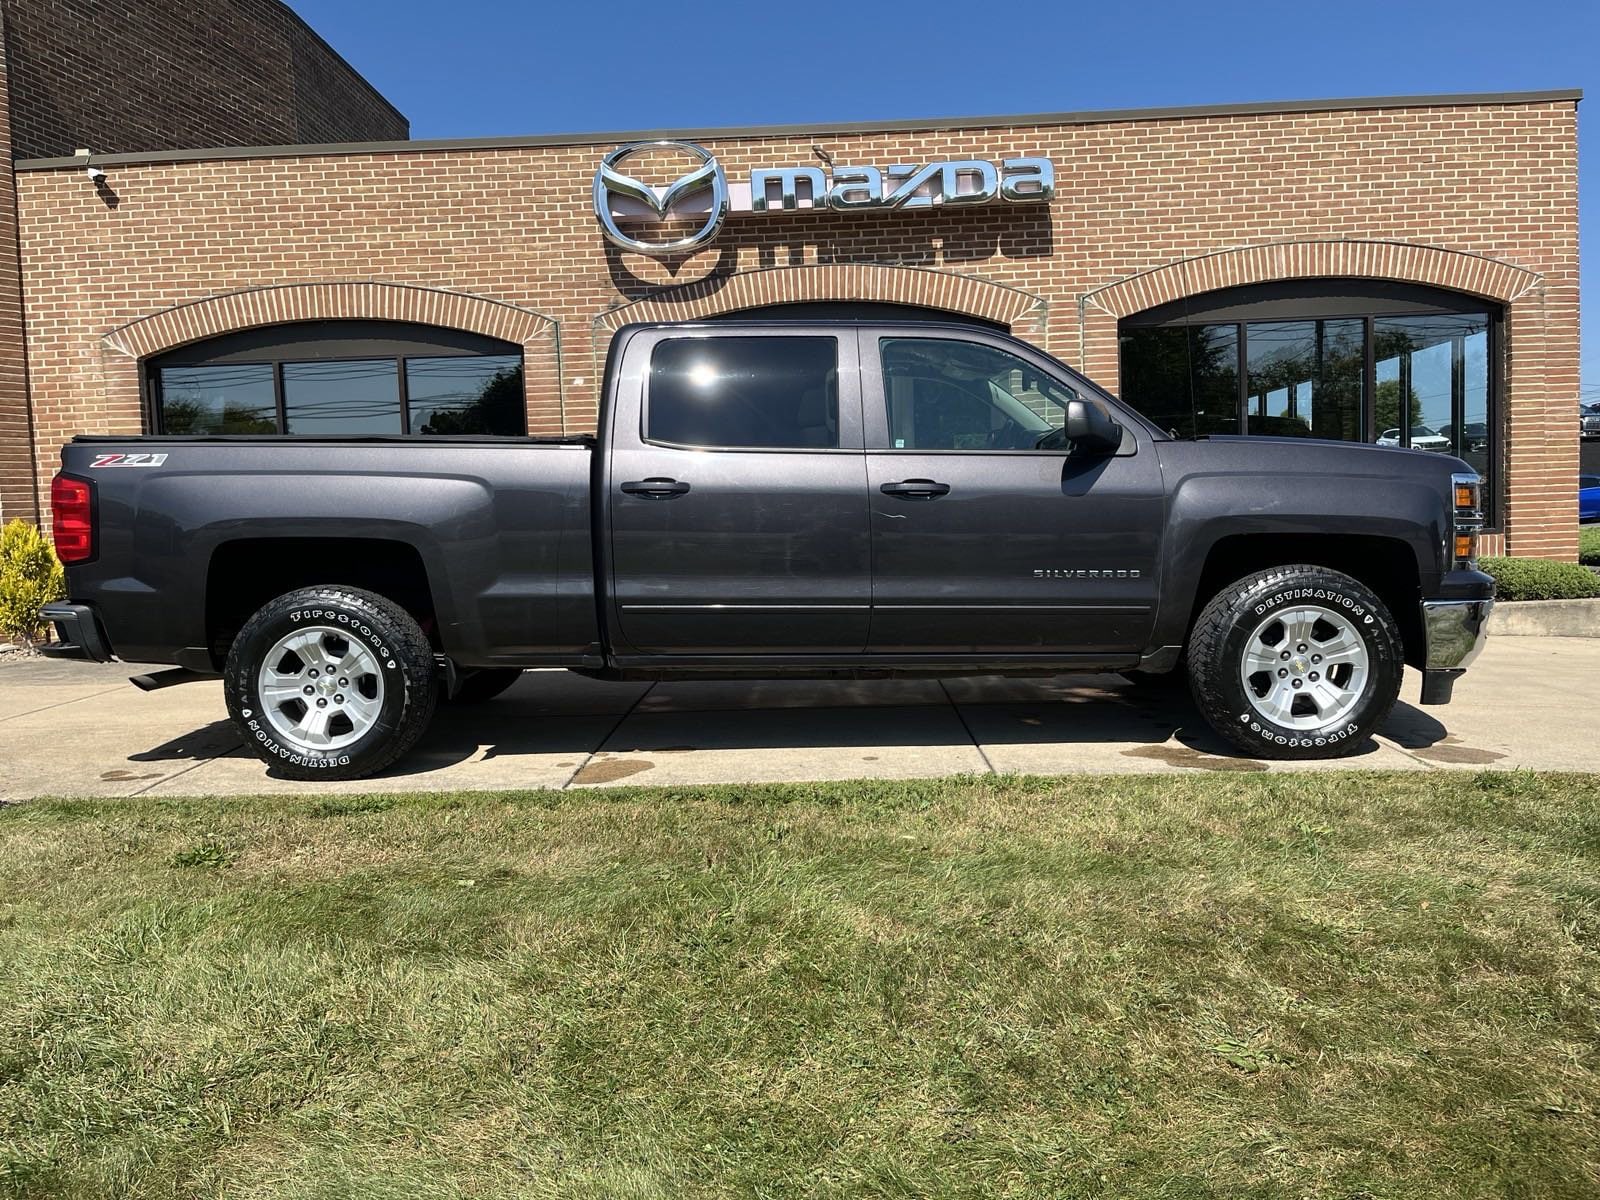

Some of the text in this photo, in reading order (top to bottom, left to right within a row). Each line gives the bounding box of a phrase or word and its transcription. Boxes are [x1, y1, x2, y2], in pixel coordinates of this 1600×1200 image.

[89, 453, 168, 468] Z71
[1033, 569, 1140, 579] SILVERADO
[1255, 588, 1364, 616] DESTINATION
[290, 610, 389, 658] Firestone
[248, 719, 350, 768] DESTINATION
[1250, 722, 1358, 747] Firestone
